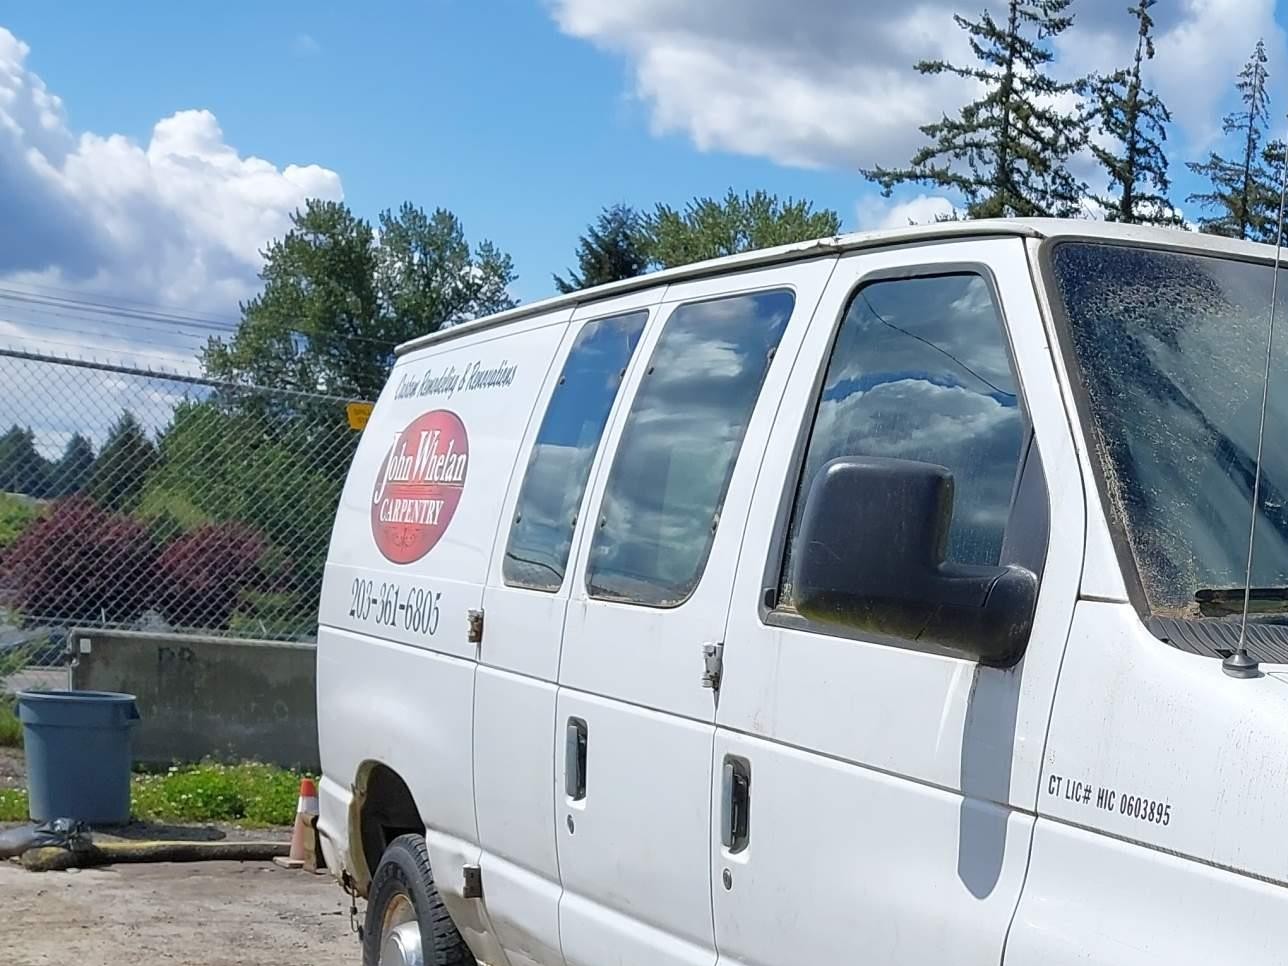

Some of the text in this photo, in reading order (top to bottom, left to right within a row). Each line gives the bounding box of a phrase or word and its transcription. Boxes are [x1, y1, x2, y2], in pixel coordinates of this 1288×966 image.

[374, 430, 467, 504] John Whelan
[379, 498, 444, 526] CARPENTRY
[349, 577, 442, 636] 203-361-6805
[1048, 774, 1172, 826] CT LIC# HIC 0603895
